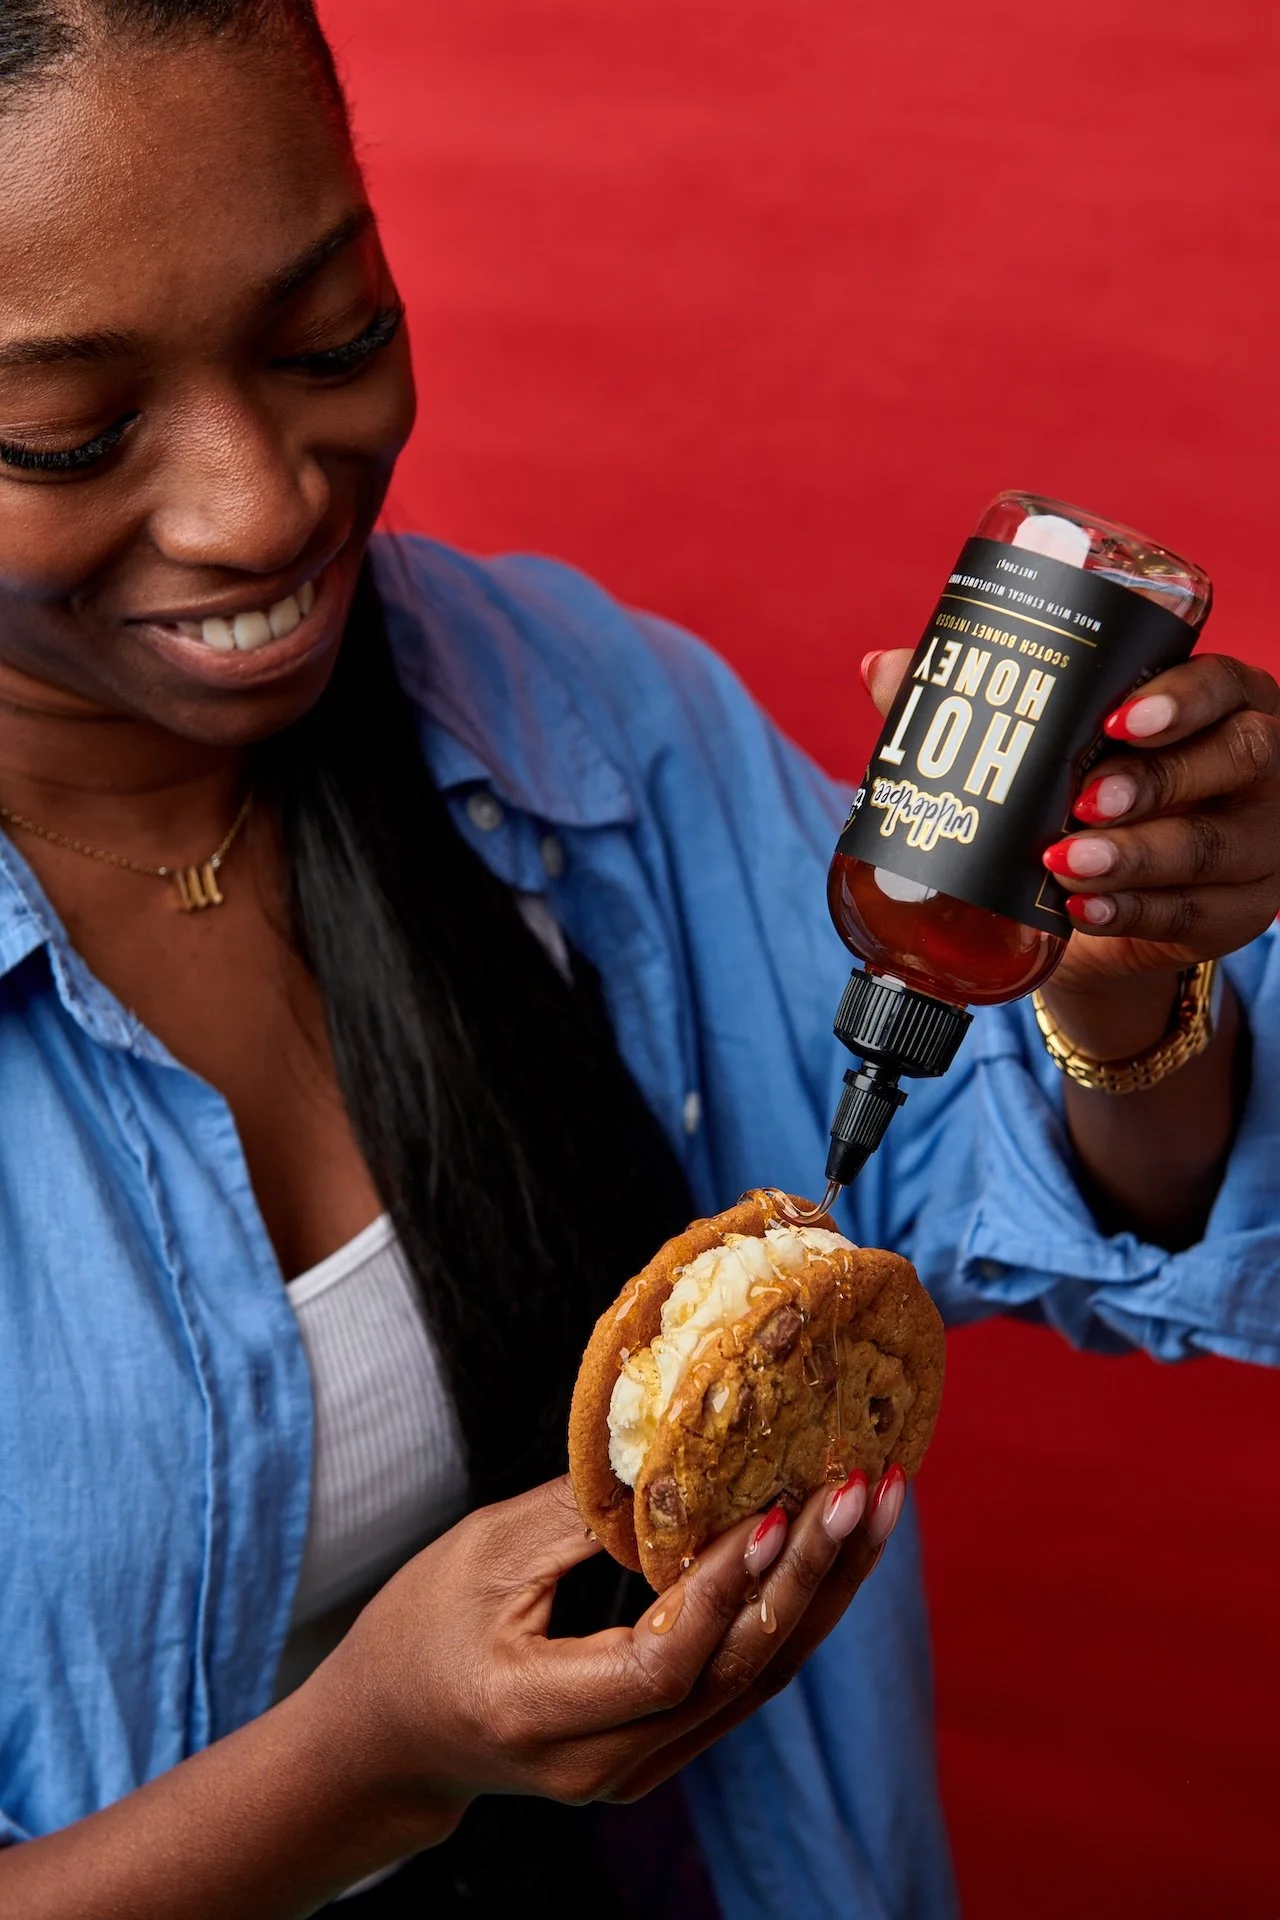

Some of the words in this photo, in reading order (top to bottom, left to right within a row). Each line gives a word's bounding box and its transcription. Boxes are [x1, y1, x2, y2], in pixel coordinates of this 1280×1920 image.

[961, 575, 1005, 596] WILDFLOWER
[1007, 590, 1045, 610] ETHICAL
[1046, 603, 1072, 619] WITH
[936, 613, 971, 633] INFUSED
[1073, 613, 1103, 632] MADE
[971, 623, 1018, 648] BONNET
[1019, 639, 1071, 668] SCOTCH
[912, 636, 1057, 721] HONEY
[878, 684, 1036, 805] HOT
